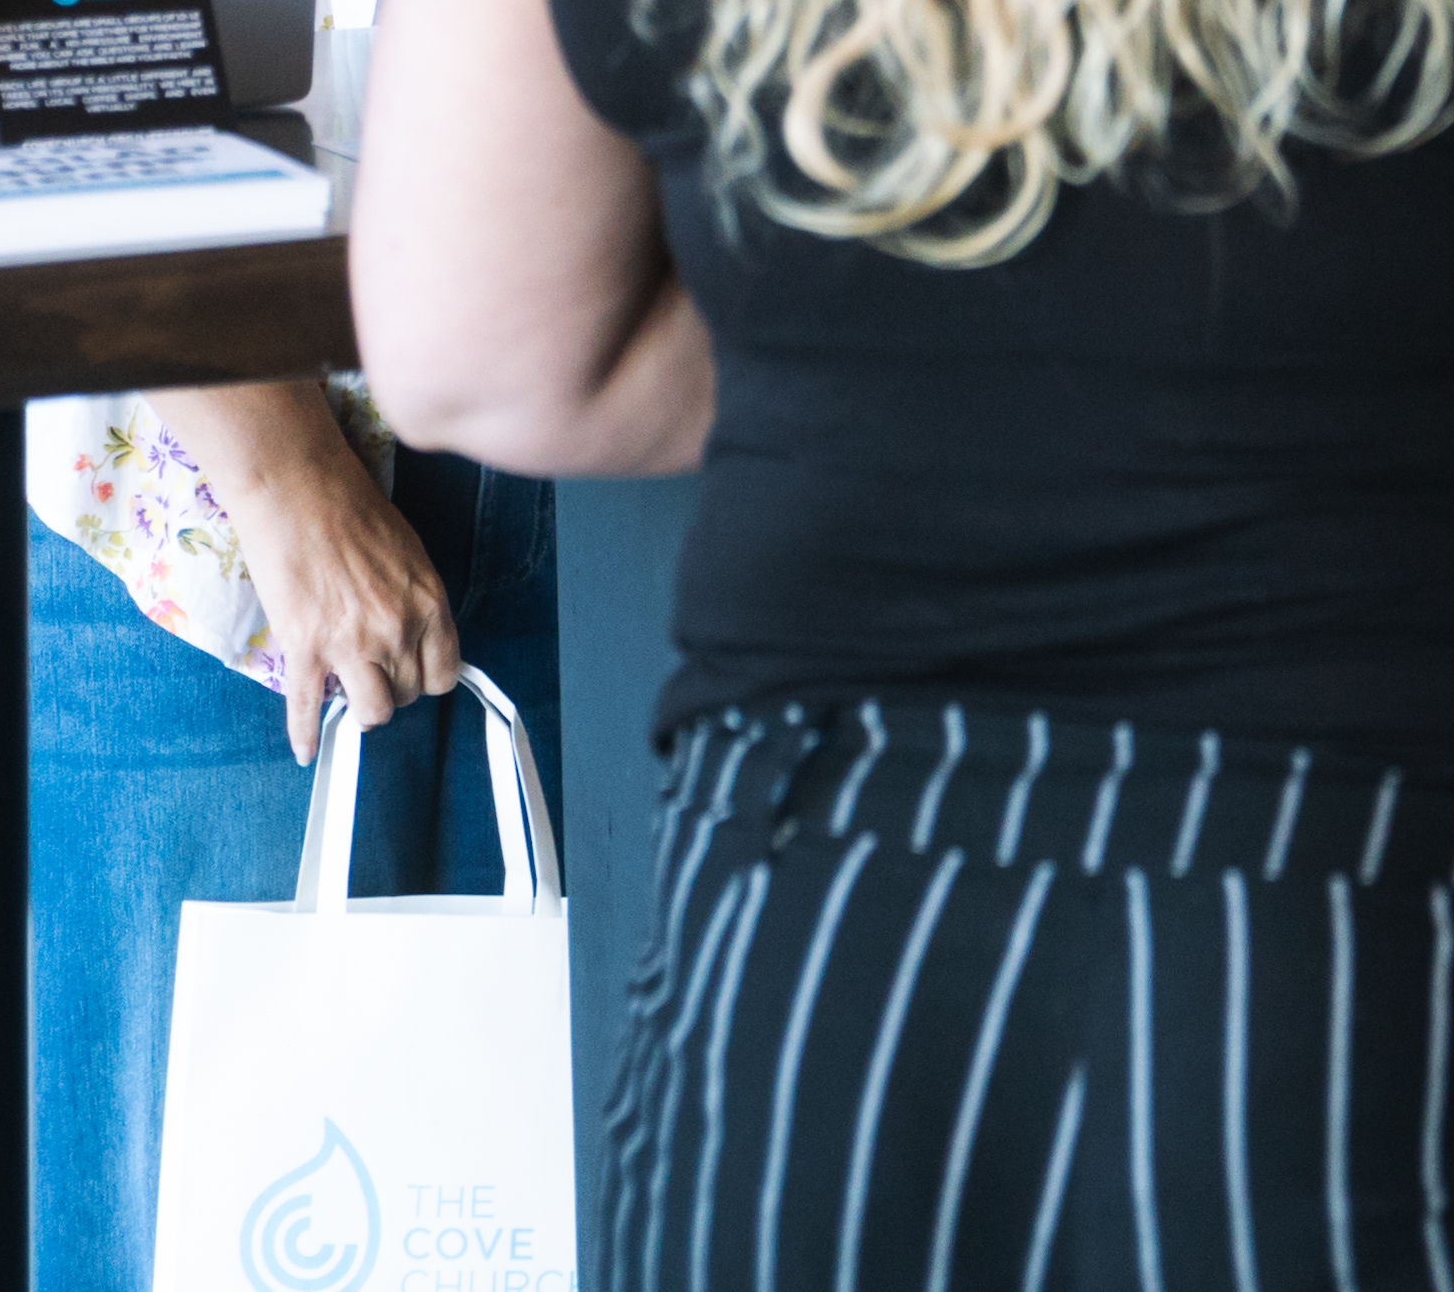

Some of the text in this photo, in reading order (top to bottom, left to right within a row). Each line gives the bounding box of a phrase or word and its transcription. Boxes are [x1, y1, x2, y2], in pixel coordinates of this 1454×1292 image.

[407, 1185, 496, 1218] THE
[402, 1228, 535, 1261] COVE
[400, 1270, 579, 1292] CHURC
